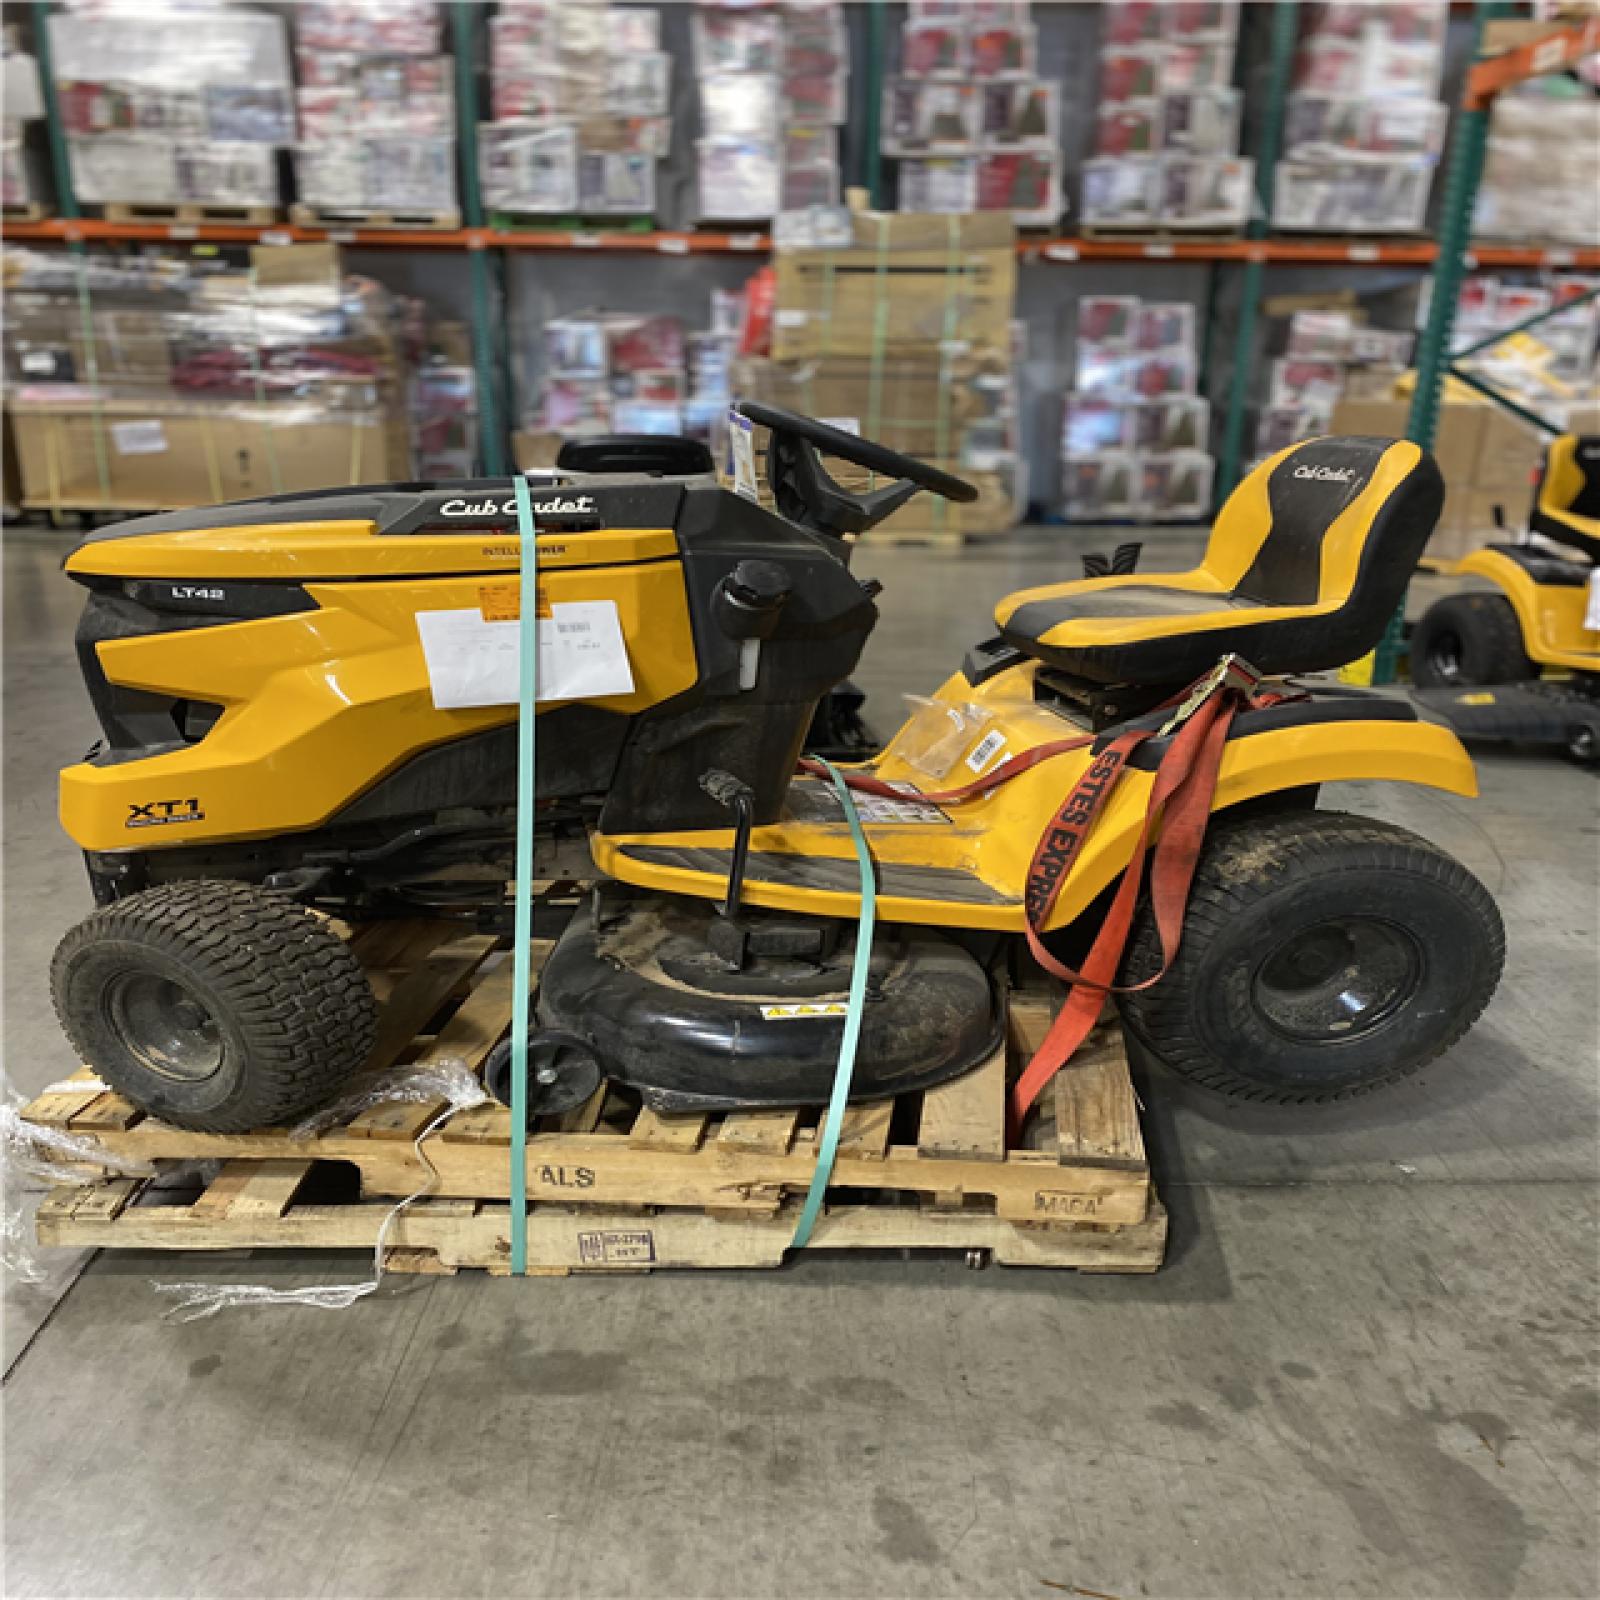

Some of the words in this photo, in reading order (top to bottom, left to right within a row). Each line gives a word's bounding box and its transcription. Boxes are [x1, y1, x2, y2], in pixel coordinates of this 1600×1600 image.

[440, 499, 498, 515] Cub
[1059, 751, 1122, 827] ESTES
[127, 798, 199, 819] XT1
[541, 1165, 596, 1188] ALS
